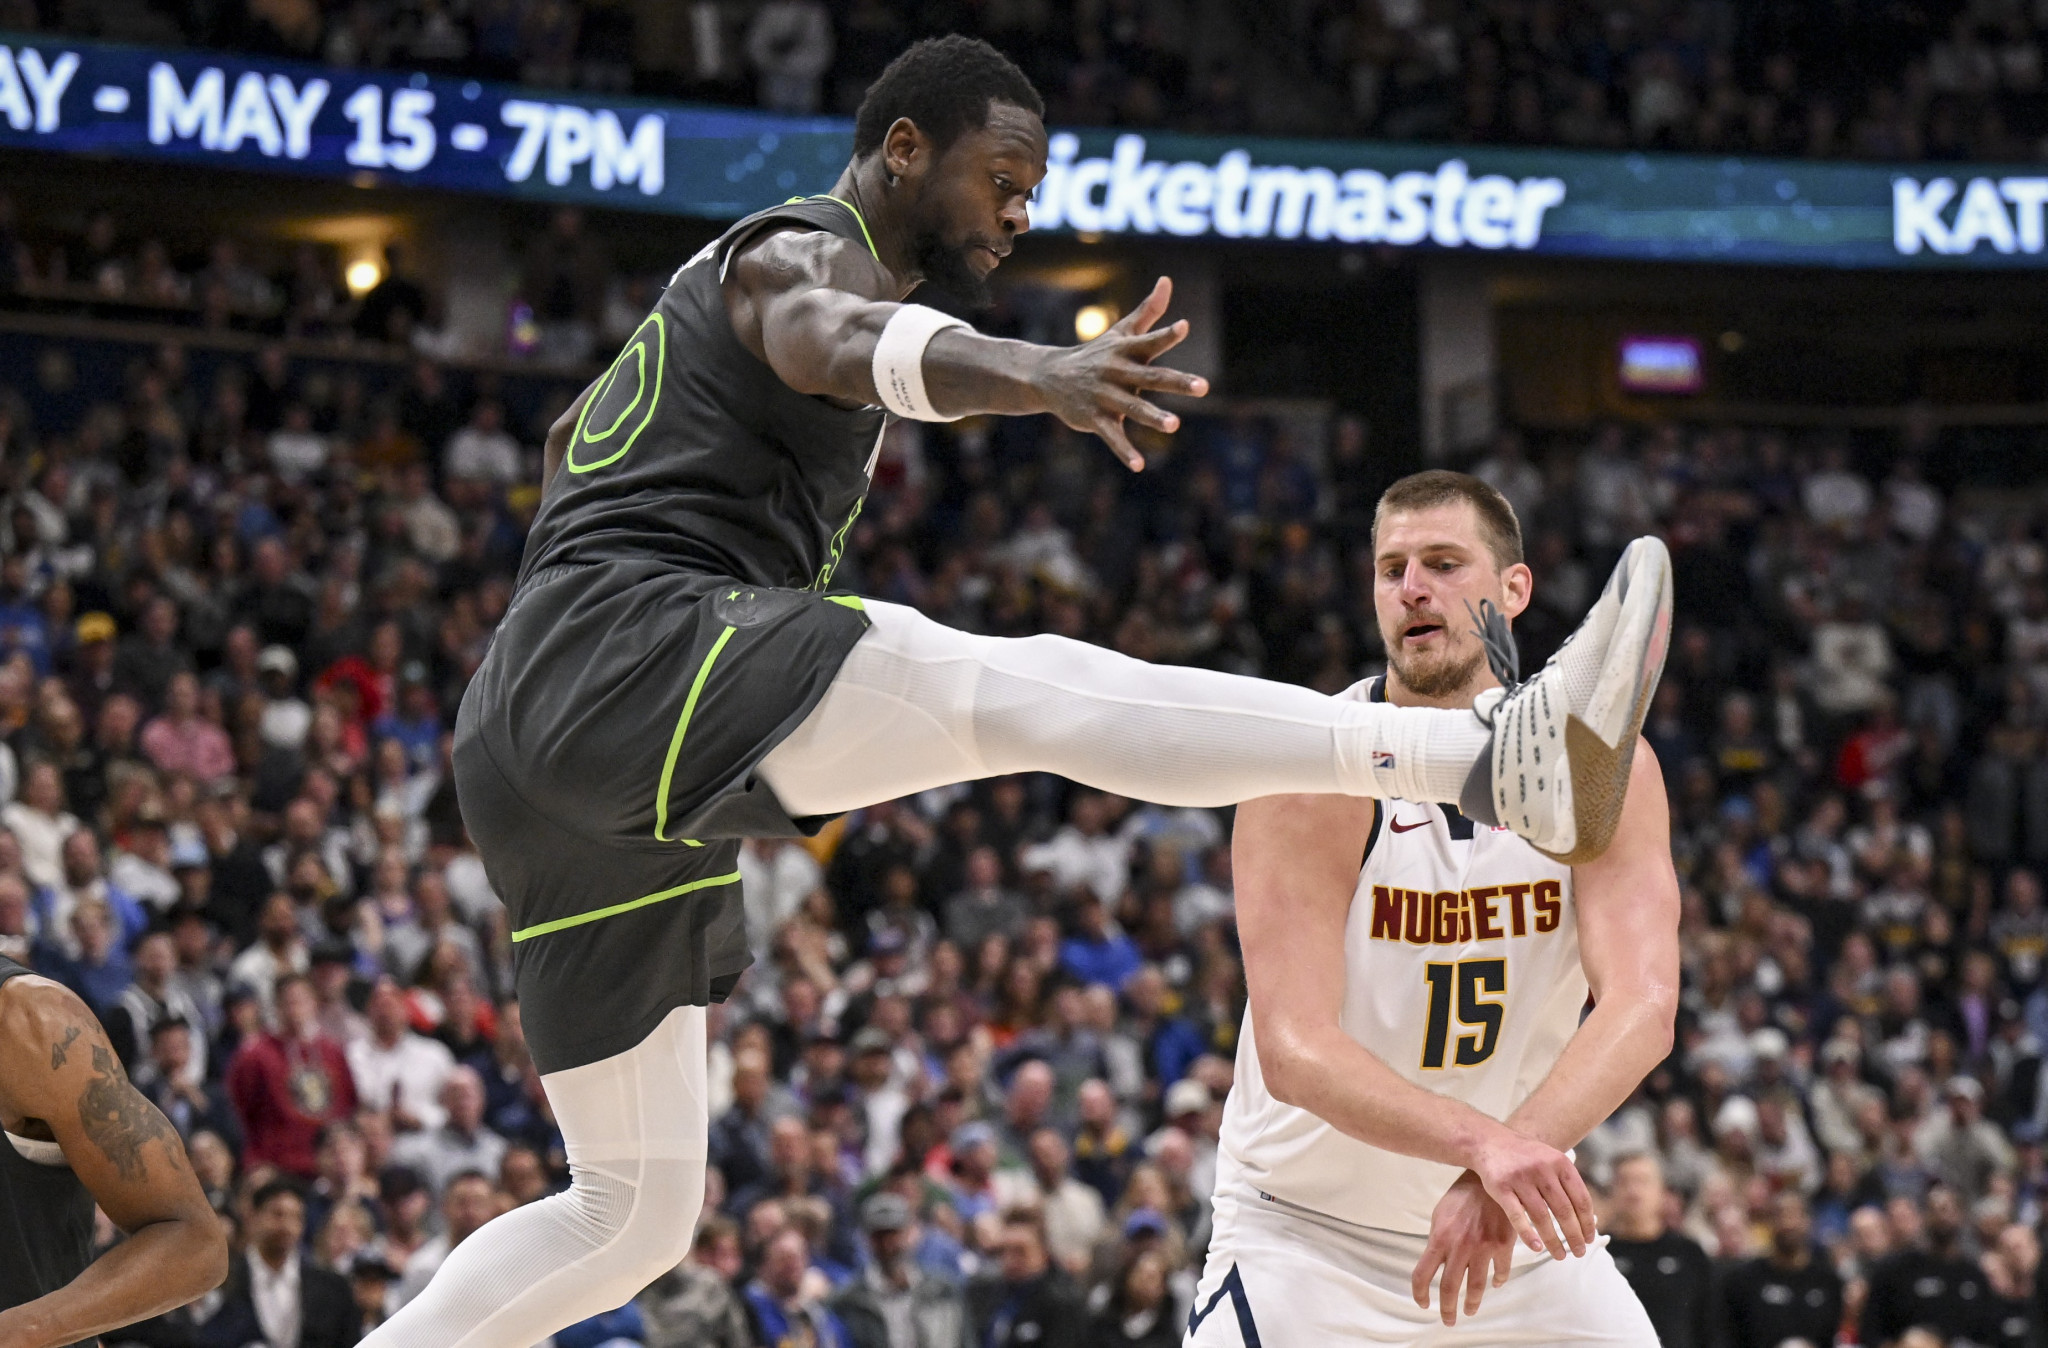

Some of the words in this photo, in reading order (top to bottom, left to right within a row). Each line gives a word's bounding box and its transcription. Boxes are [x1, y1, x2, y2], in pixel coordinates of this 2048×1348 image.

[148, 61, 331, 159] MAY
[342, 84, 437, 171] 15
[501, 99, 664, 196] 7PM
[1892, 176, 2048, 255] KAT
[1419, 957, 1507, 1071] 15
